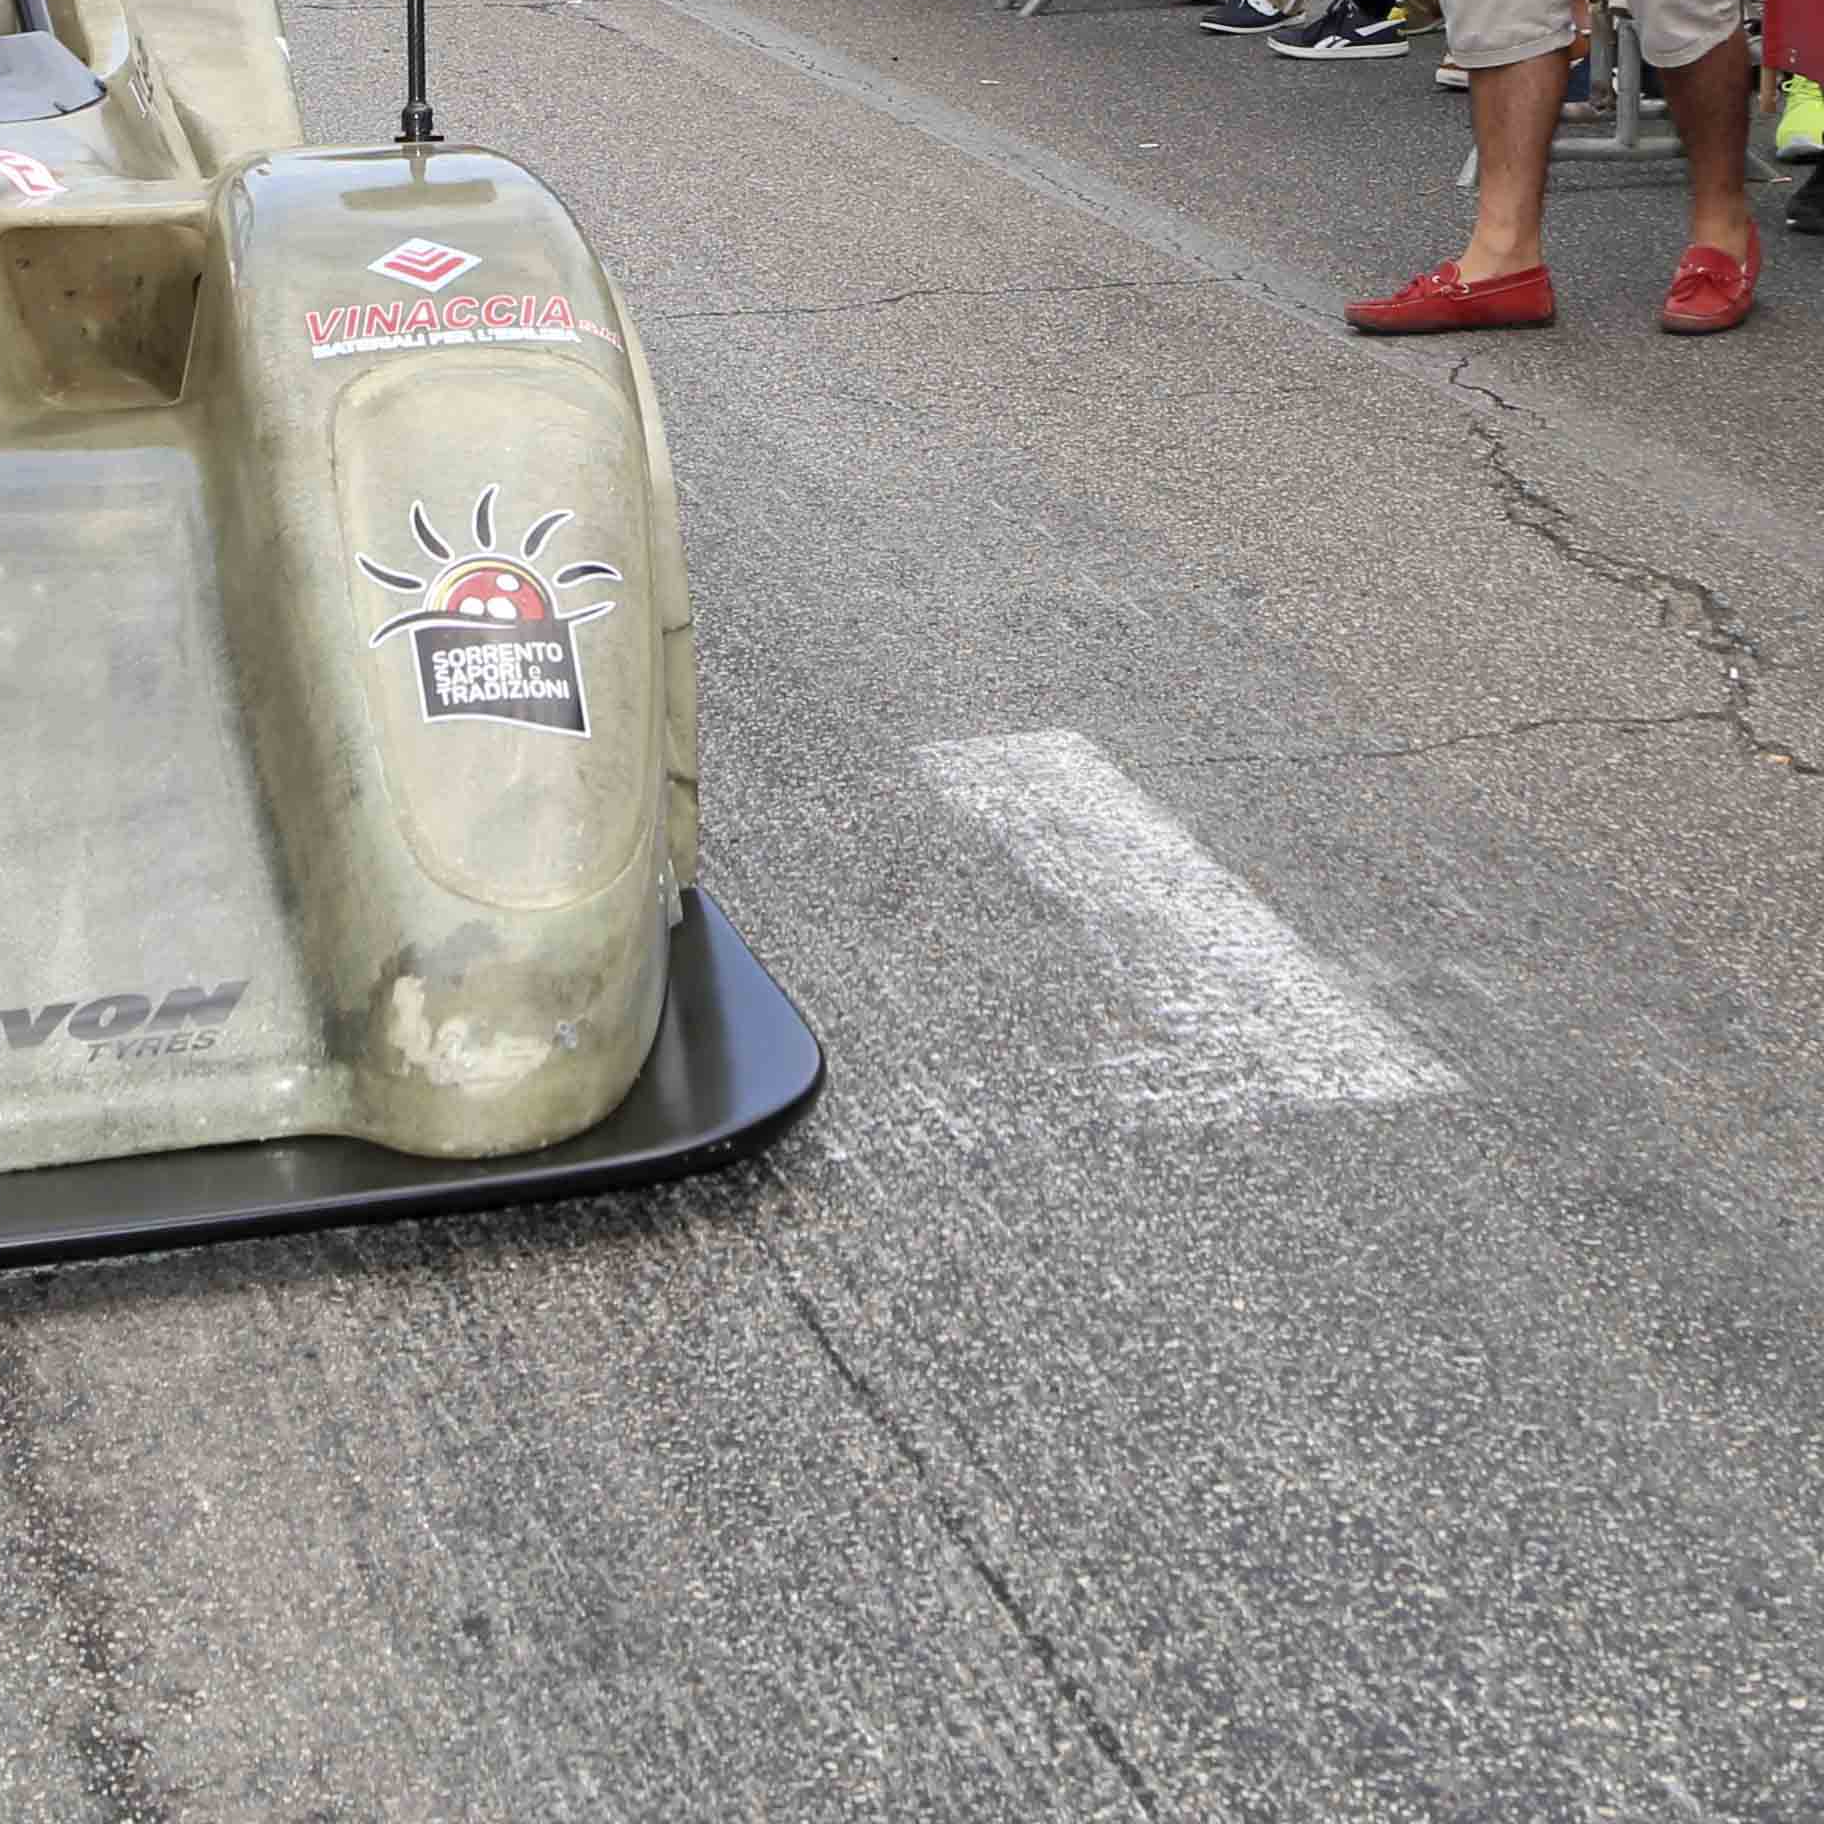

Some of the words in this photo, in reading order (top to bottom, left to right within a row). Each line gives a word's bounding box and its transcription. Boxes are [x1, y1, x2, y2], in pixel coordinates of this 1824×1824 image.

[305, 295, 576, 345] VINACCIA
[431, 641, 564, 673] SORRENTO
[434, 664, 523, 690] SAPORI
[436, 678, 571, 707] TRADIZIONI
